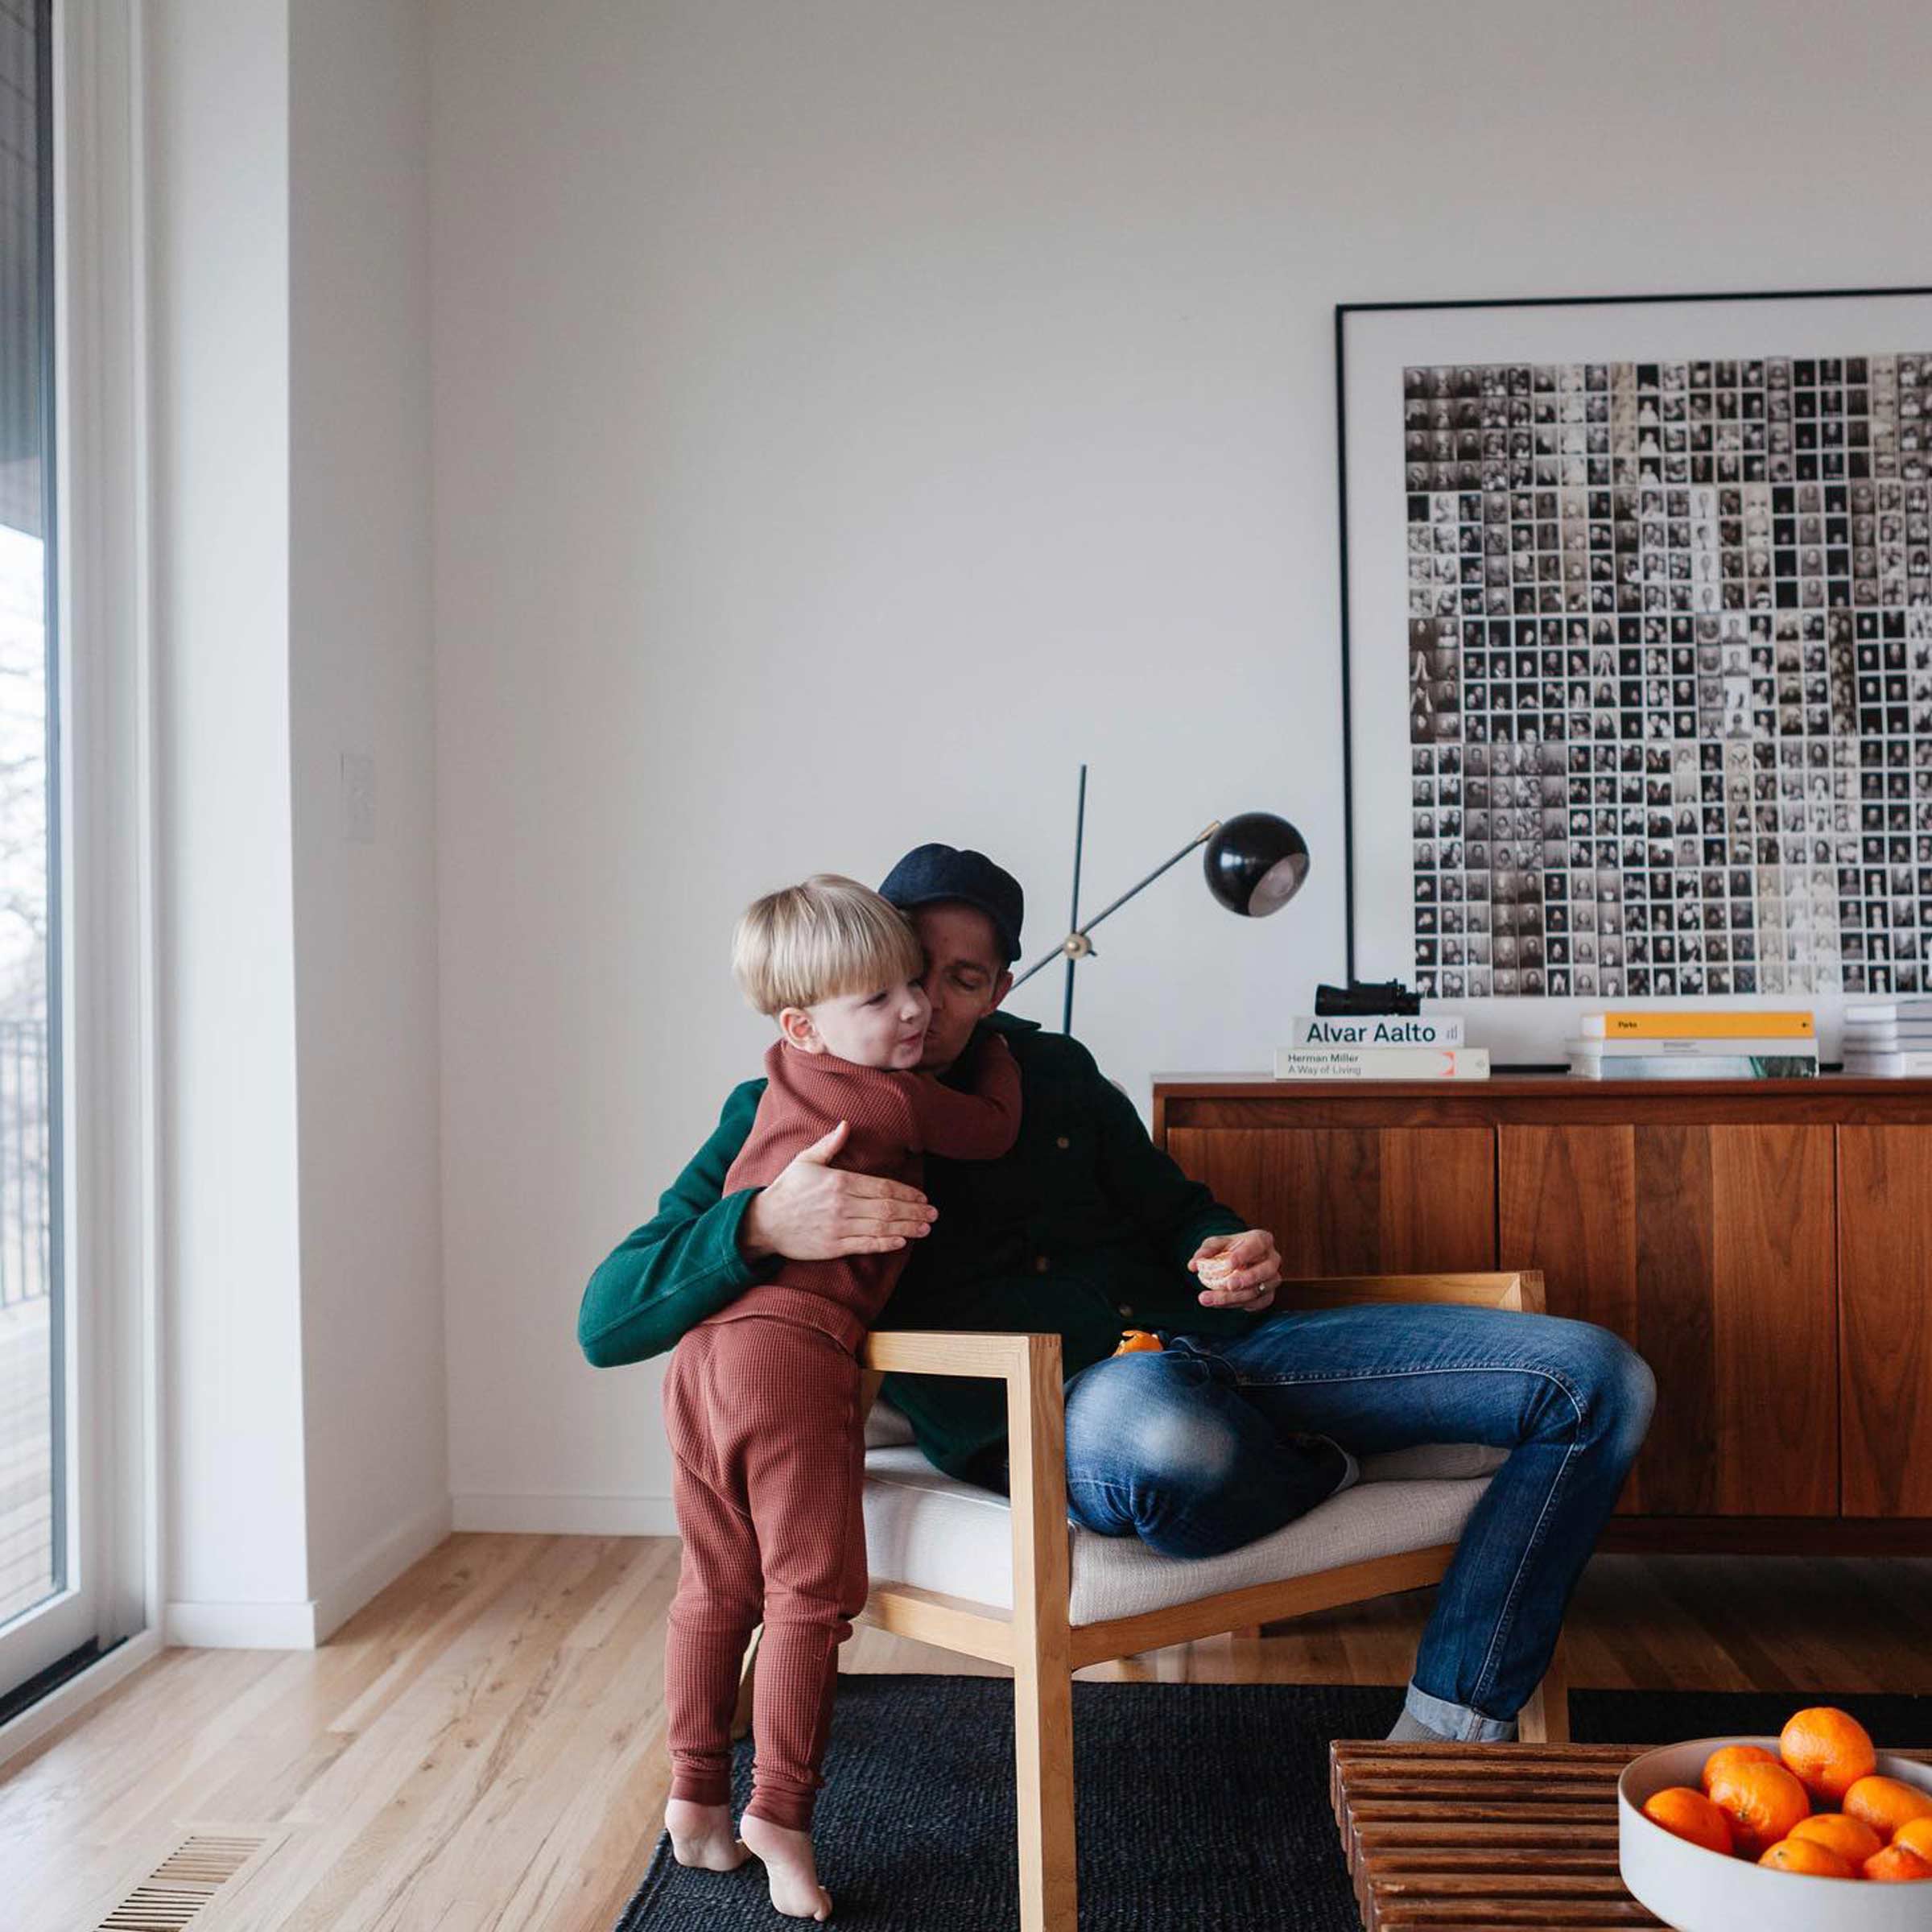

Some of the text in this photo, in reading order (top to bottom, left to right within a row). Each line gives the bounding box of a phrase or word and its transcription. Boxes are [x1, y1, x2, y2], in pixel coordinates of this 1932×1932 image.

[1307, 1022, 1367, 1042] Alvar
[1373, 1022, 1436, 1042] Aalto
[1288, 1053, 1359, 1063] Herman Miller
[1288, 1064, 1361, 1076] A Way of Living
